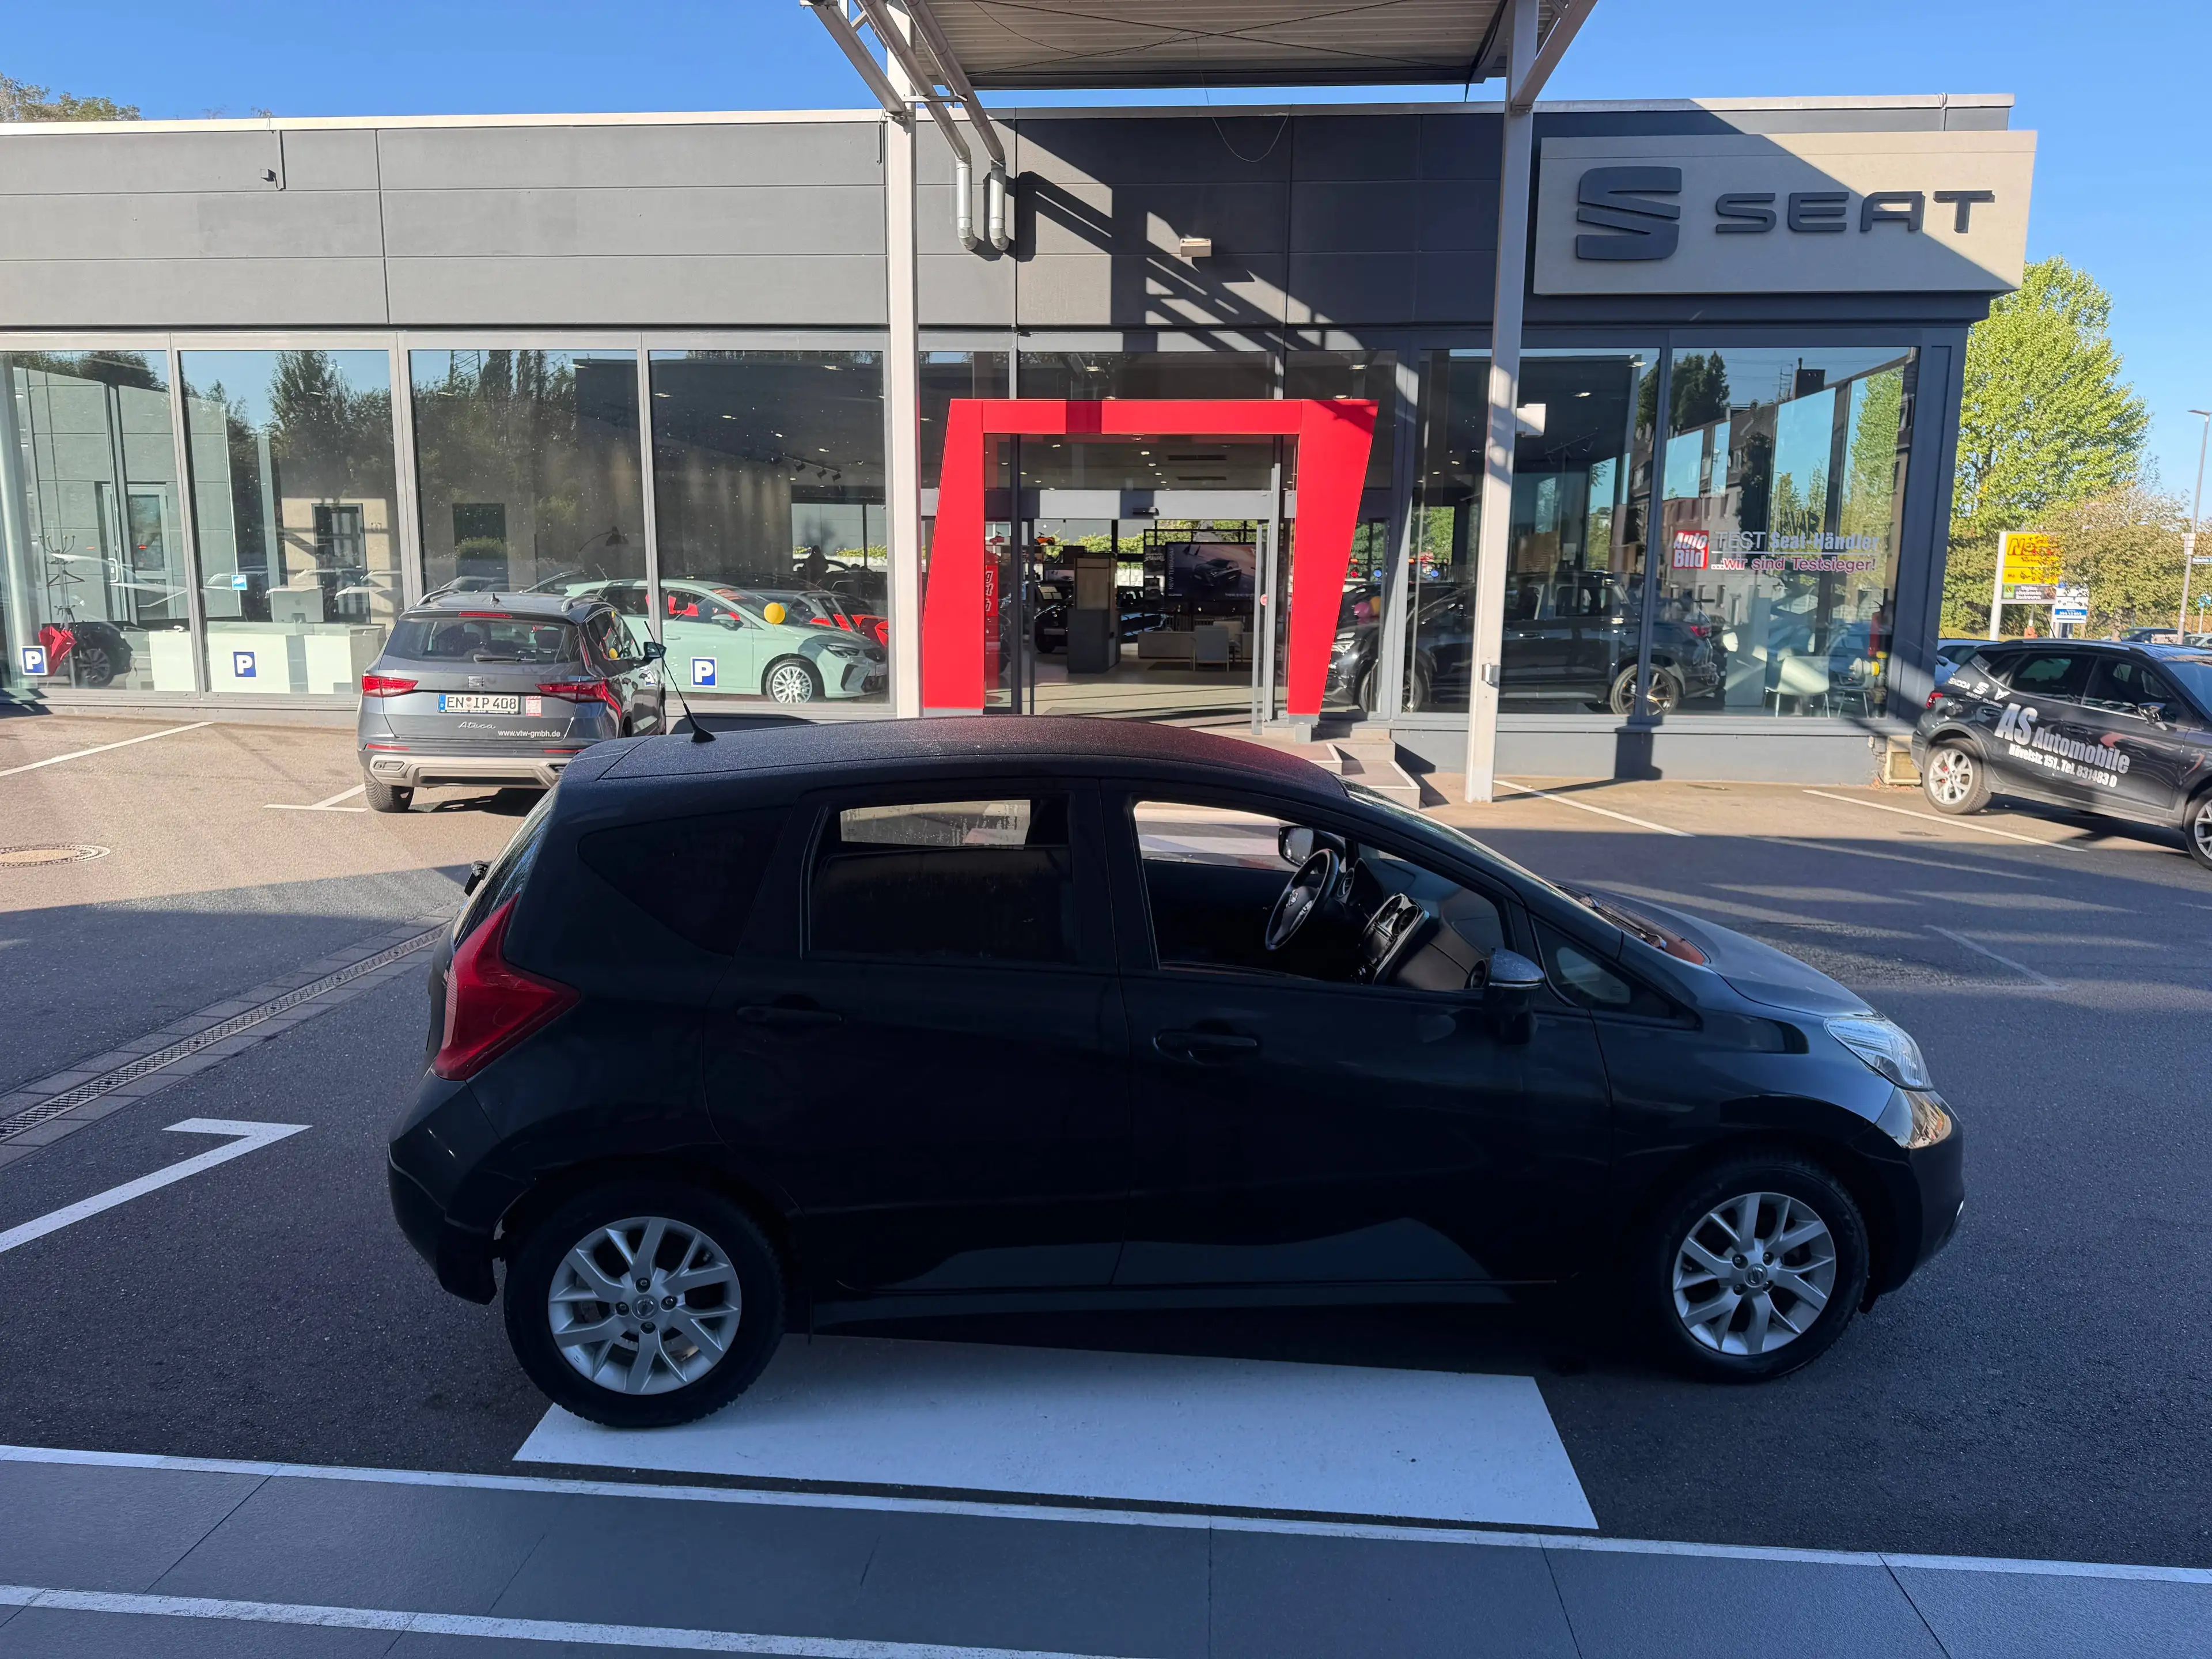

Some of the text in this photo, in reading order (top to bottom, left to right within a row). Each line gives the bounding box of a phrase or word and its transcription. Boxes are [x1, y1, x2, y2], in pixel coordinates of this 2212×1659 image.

[1715, 190, 1995, 234] SEAT
[1673, 532, 1708, 550] Auto
[1715, 531, 1880, 550] TEST Seat-Händler
[1674, 549, 1705, 567] Bild
[1751, 556, 1785, 571] sind
[1792, 557, 1876, 573] Testsieger!
[25, 652, 41, 669] P
[237, 655, 253, 674] P
[694, 660, 714, 683] P
[447, 696, 464, 708] EN
[474, 697, 490, 709] IP
[493, 698, 517, 710] 408
[457, 721, 497, 730] Ateca
[498, 729, 561, 738] www.vtw-gmbh.de
[1994, 702, 2130, 774] AS Automobile
